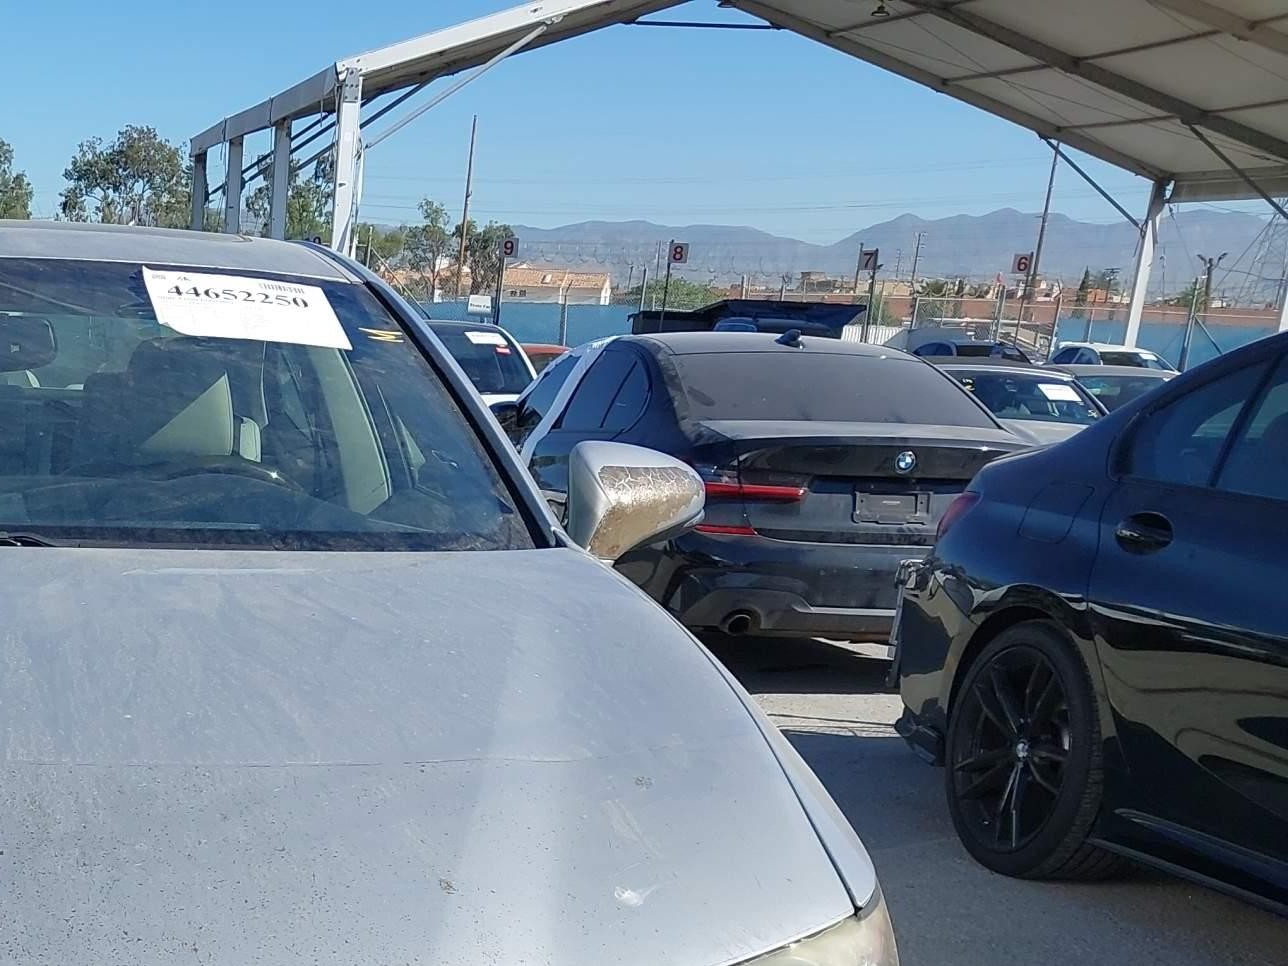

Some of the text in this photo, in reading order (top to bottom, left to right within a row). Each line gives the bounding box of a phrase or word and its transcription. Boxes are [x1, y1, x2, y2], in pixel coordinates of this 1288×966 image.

[503, 240, 515, 256] 9
[672, 245, 684, 261] 8
[863, 252, 874, 269] 7
[1016, 256, 1029, 272] 6
[167, 284, 309, 308] 44652250
